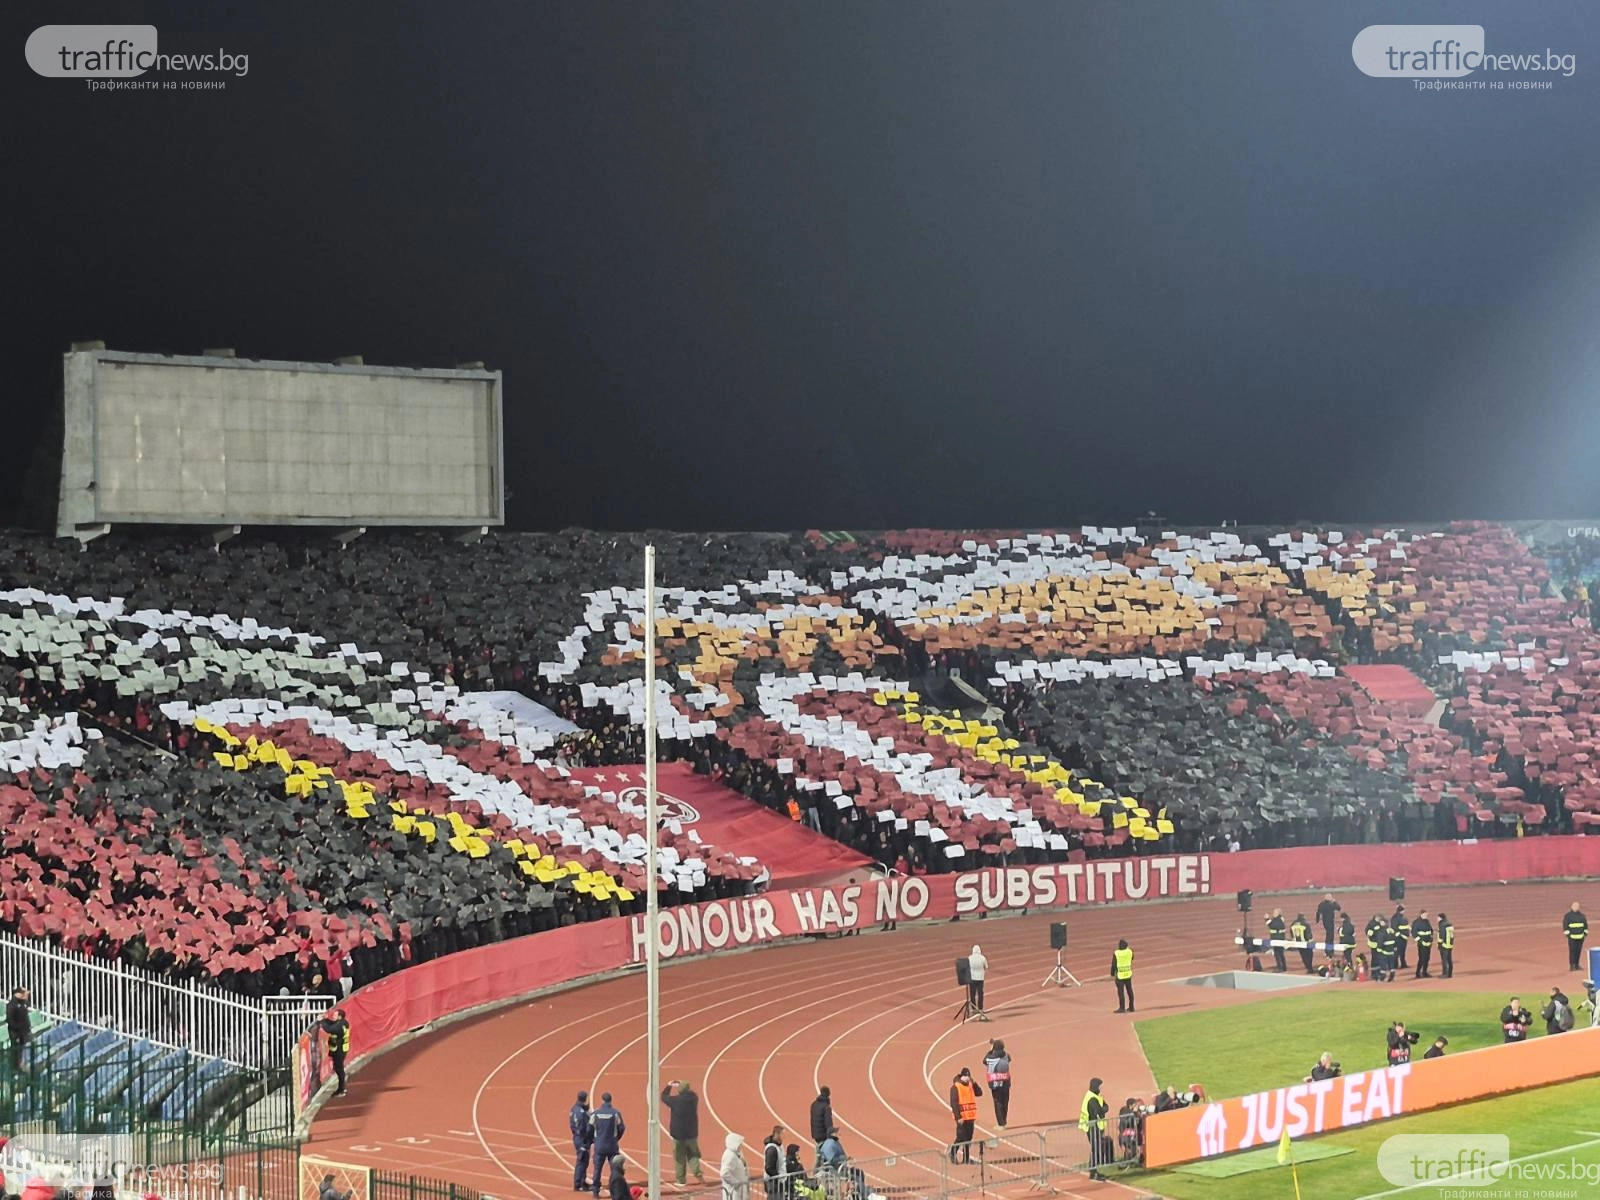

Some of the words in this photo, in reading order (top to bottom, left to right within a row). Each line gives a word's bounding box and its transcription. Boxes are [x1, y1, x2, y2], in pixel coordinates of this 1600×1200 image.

[631, 898, 781, 962] HONOUR
[791, 886, 861, 931] HAS
[876, 877, 929, 921] NO
[955, 855, 1210, 912] SUBSTITUTE!
[1239, 1080, 1332, 1149] JUST
[1341, 1062, 1412, 1126] EAT
